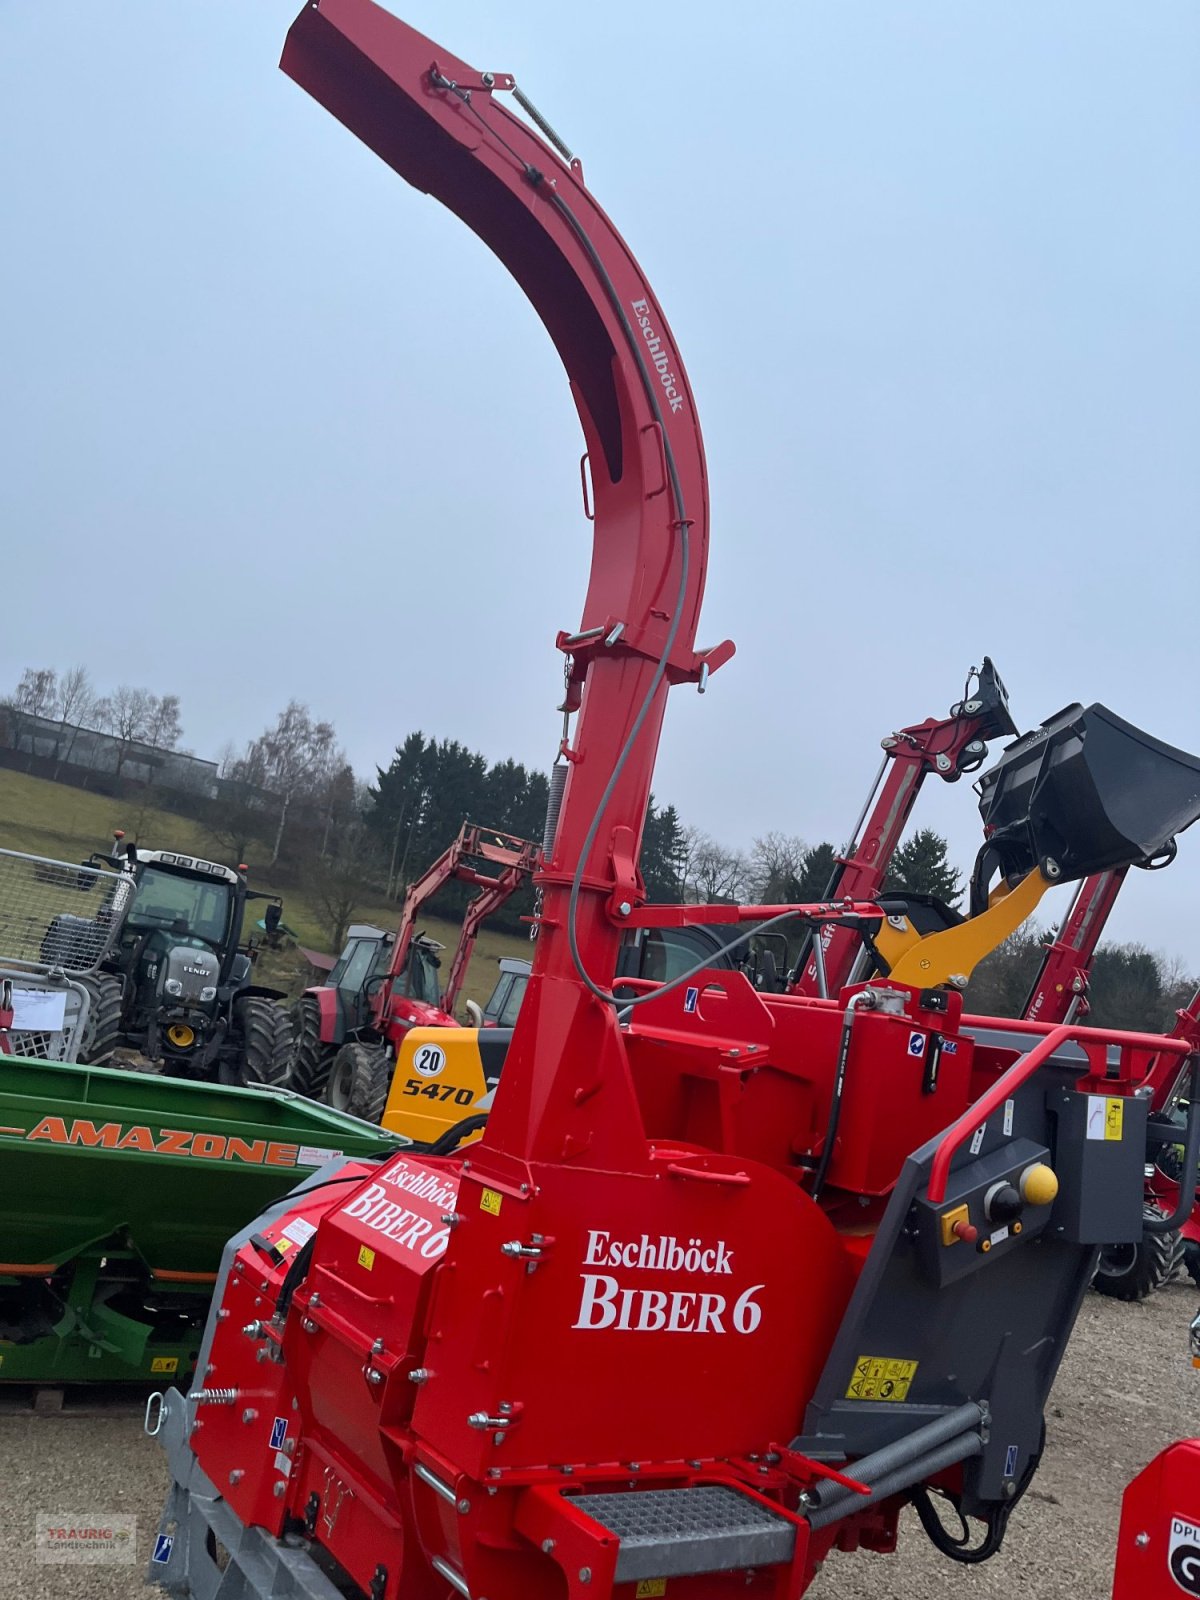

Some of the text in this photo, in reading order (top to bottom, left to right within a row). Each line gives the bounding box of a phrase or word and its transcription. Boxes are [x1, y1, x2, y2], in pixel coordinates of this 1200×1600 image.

[631, 298, 683, 414] Eschlböck
[183, 965, 211, 977] FENDT
[419, 1049, 441, 1072] 20
[402, 1079, 475, 1106] 5470
[26, 1116, 299, 1167] AMAZONE
[341, 1183, 433, 1251] BIBER
[420, 1227, 451, 1259] 6
[582, 1229, 734, 1275] Eschlböck
[571, 1273, 766, 1335] BIBER 6
